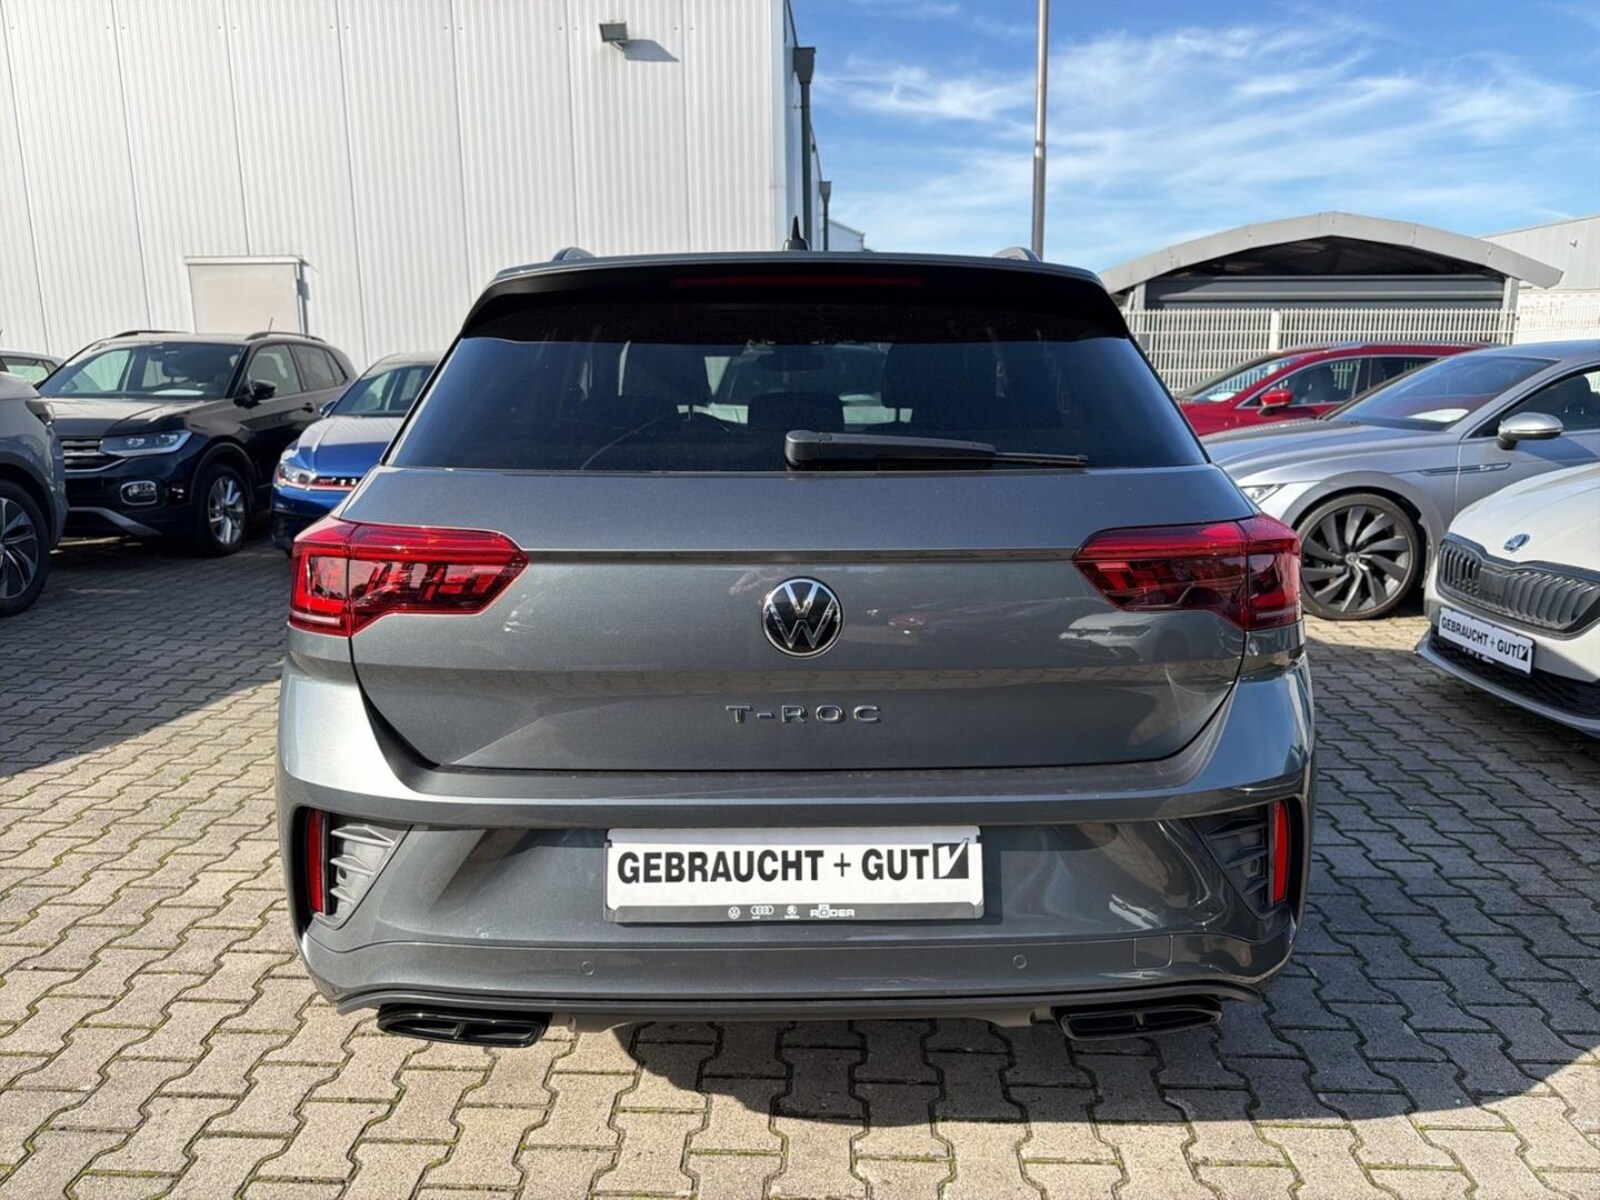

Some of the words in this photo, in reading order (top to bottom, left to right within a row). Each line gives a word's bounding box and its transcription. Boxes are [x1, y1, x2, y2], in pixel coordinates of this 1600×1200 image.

[1442, 617, 1488, 646] GEBRAUCHT
[1497, 639, 1518, 659] GUT
[725, 704, 881, 724] T-ROC
[617, 849, 824, 884] GEBRAUCHT
[834, 852, 851, 878] +
[861, 848, 929, 881] GUT
